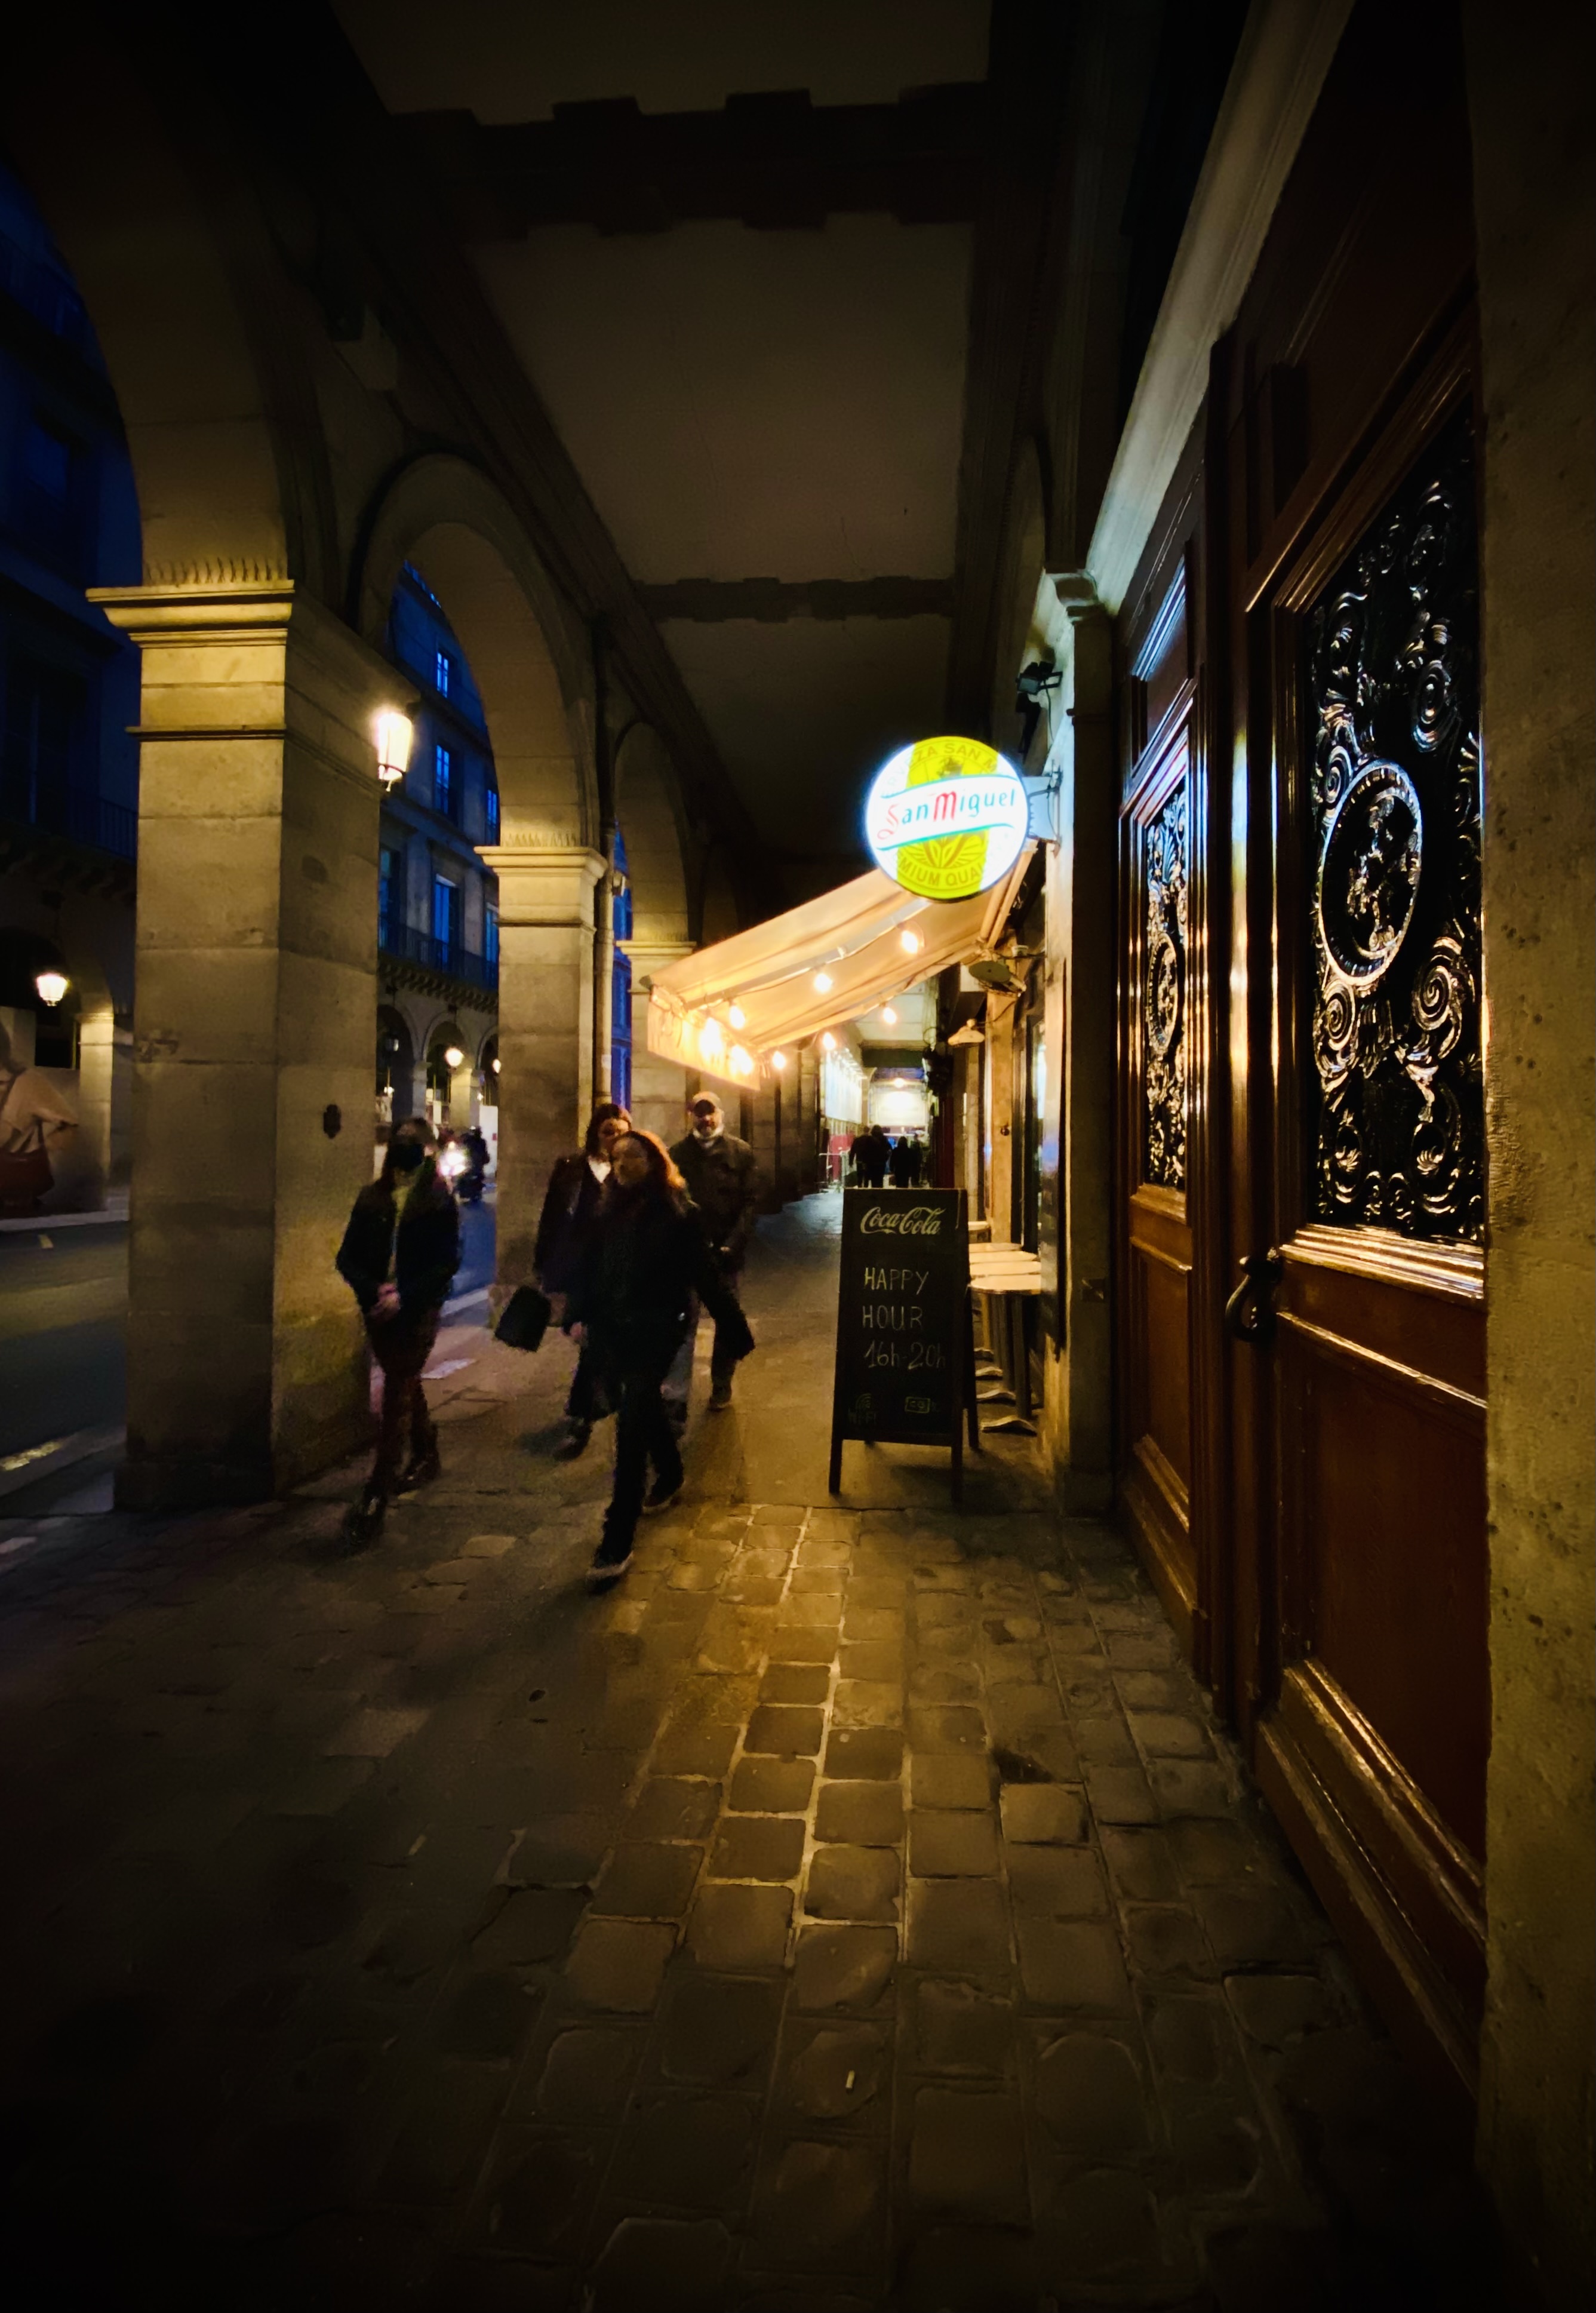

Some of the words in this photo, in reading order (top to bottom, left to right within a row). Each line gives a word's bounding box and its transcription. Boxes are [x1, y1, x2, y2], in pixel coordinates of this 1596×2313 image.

[944, 743, 980, 760] SAN
[877, 803, 929, 840] San
[933, 788, 1016, 822] Miguel
[860, 1206, 946, 1236] Coca-Cola
[864, 1267, 929, 1295] HAPPY
[862, 1305, 924, 1331] HOUR
